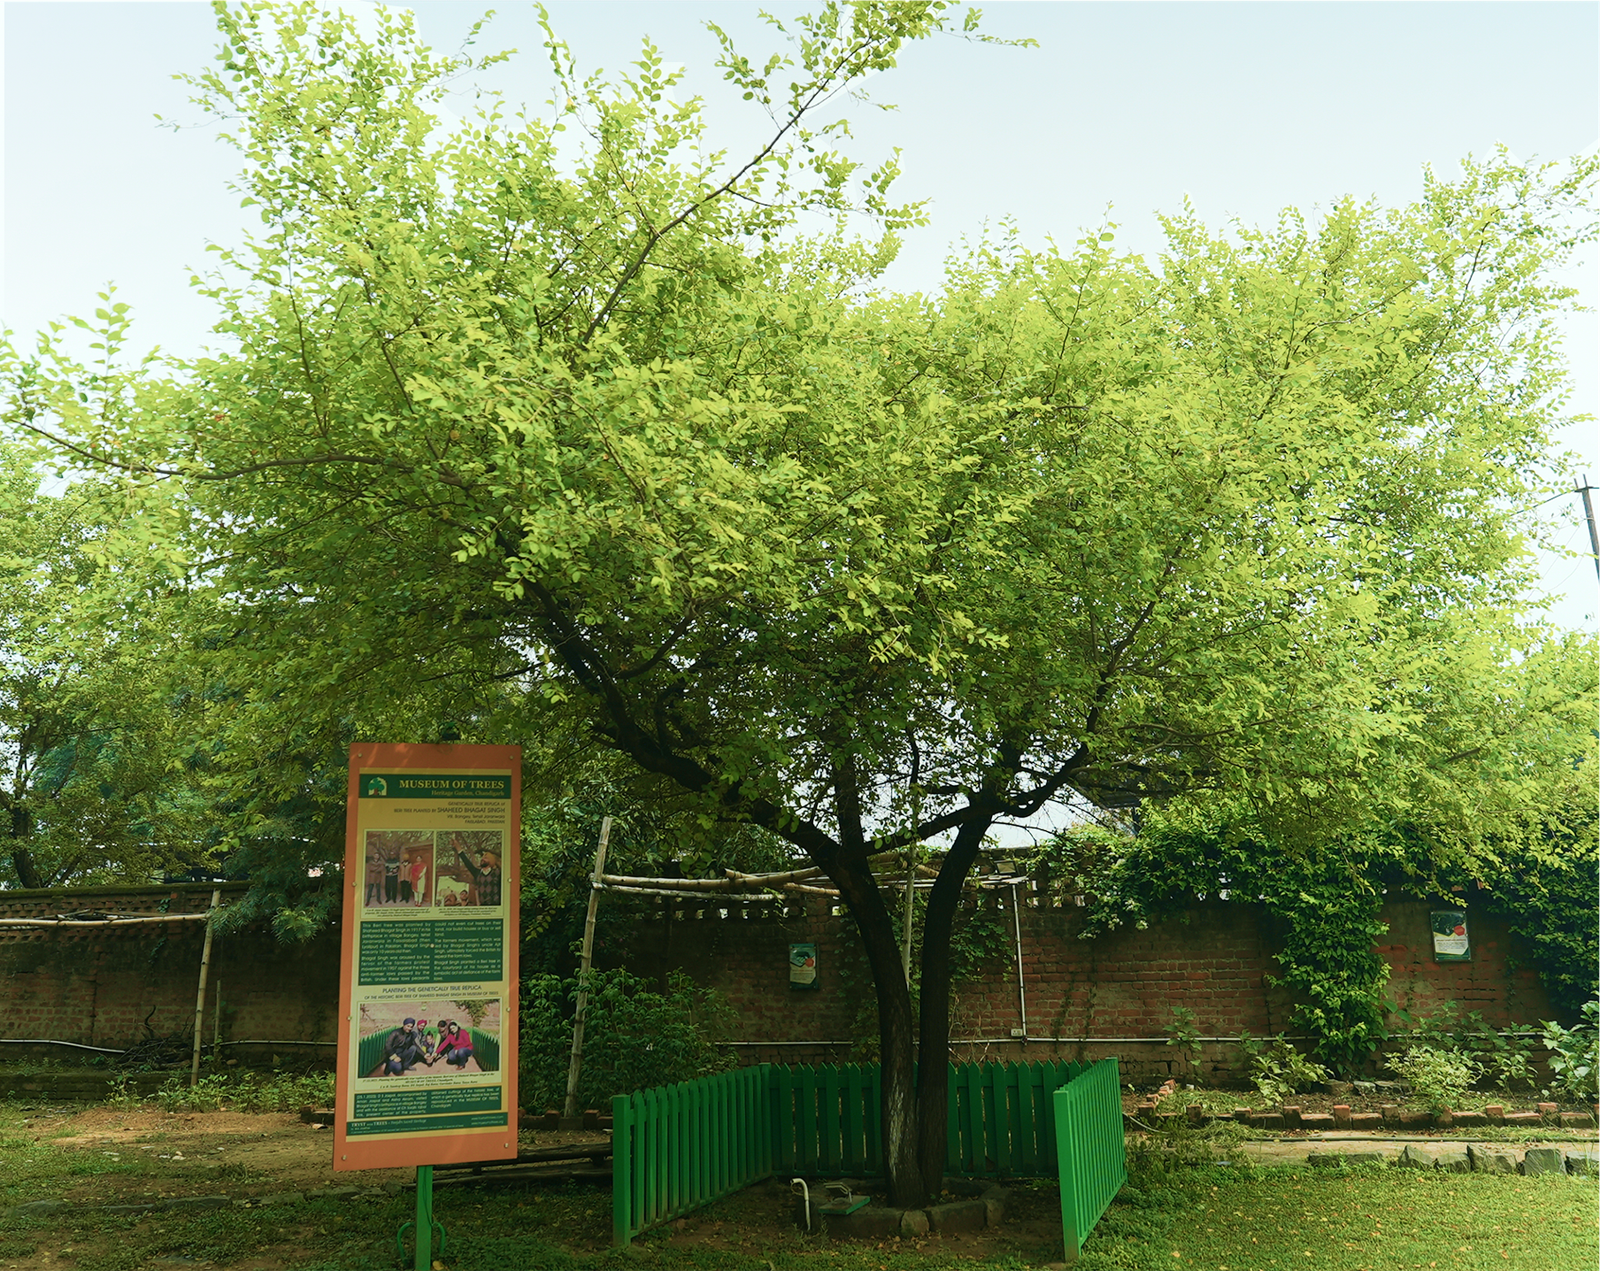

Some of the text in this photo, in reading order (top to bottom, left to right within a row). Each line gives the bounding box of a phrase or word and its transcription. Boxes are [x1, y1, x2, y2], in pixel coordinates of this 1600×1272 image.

[400, 780, 505, 789] MUSEUM OF TREES
